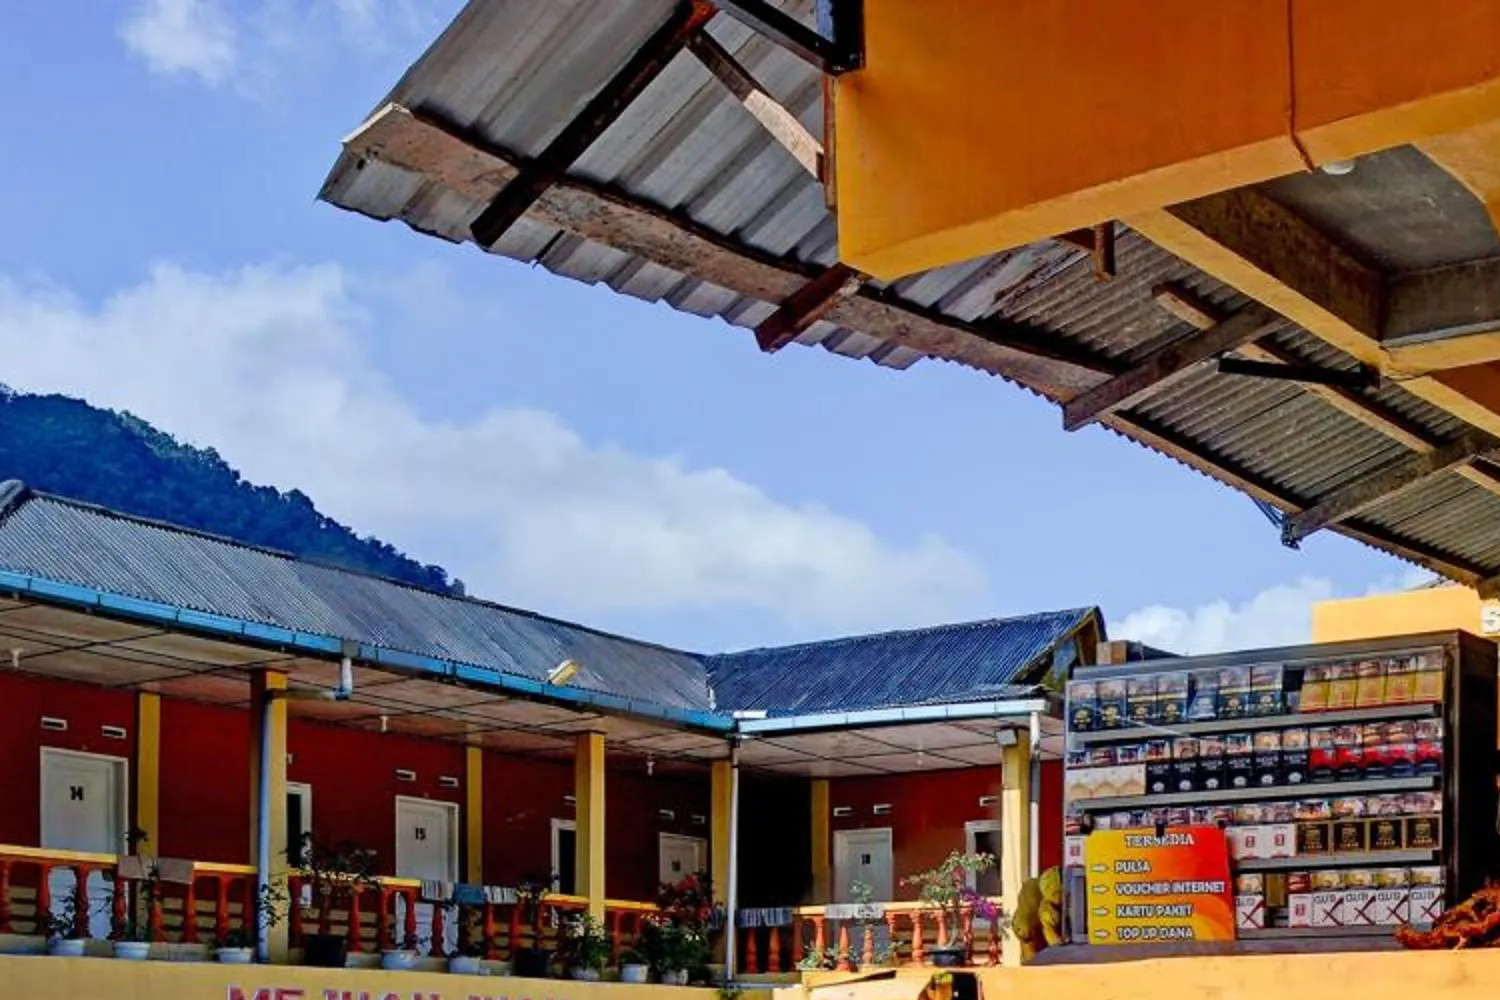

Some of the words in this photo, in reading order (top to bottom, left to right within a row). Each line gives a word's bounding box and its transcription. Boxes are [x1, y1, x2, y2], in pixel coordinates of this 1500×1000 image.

[1115, 860, 1152, 873] PULSA
[1115, 882, 1171, 896] VOUCHER
[1172, 881, 1225, 894] INTERNET
[1116, 904, 1155, 917] KARTU
[1156, 904, 1193, 917] PAKET
[1117, 926, 1140, 940] TOP
[1142, 926, 1157, 939] UP
[1159, 926, 1193, 939] DANA
